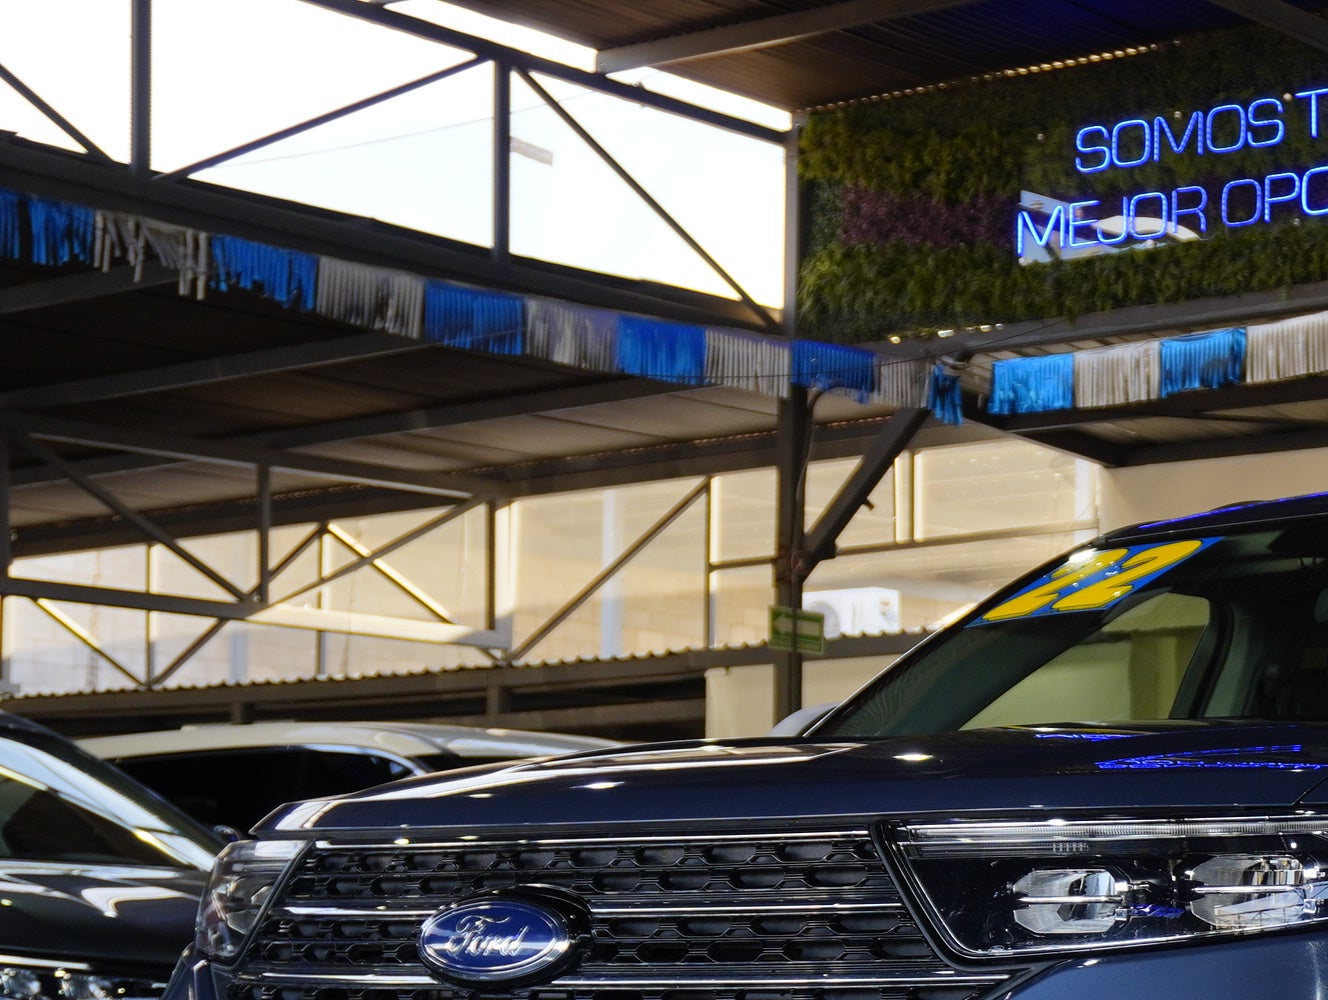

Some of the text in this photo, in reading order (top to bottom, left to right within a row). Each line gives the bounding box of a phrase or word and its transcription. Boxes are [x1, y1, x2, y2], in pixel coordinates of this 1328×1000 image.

[1074, 97, 1286, 175] SOMOS
[1016, 184, 1209, 257] MEJOR
[445, 914, 530, 957] Ford
